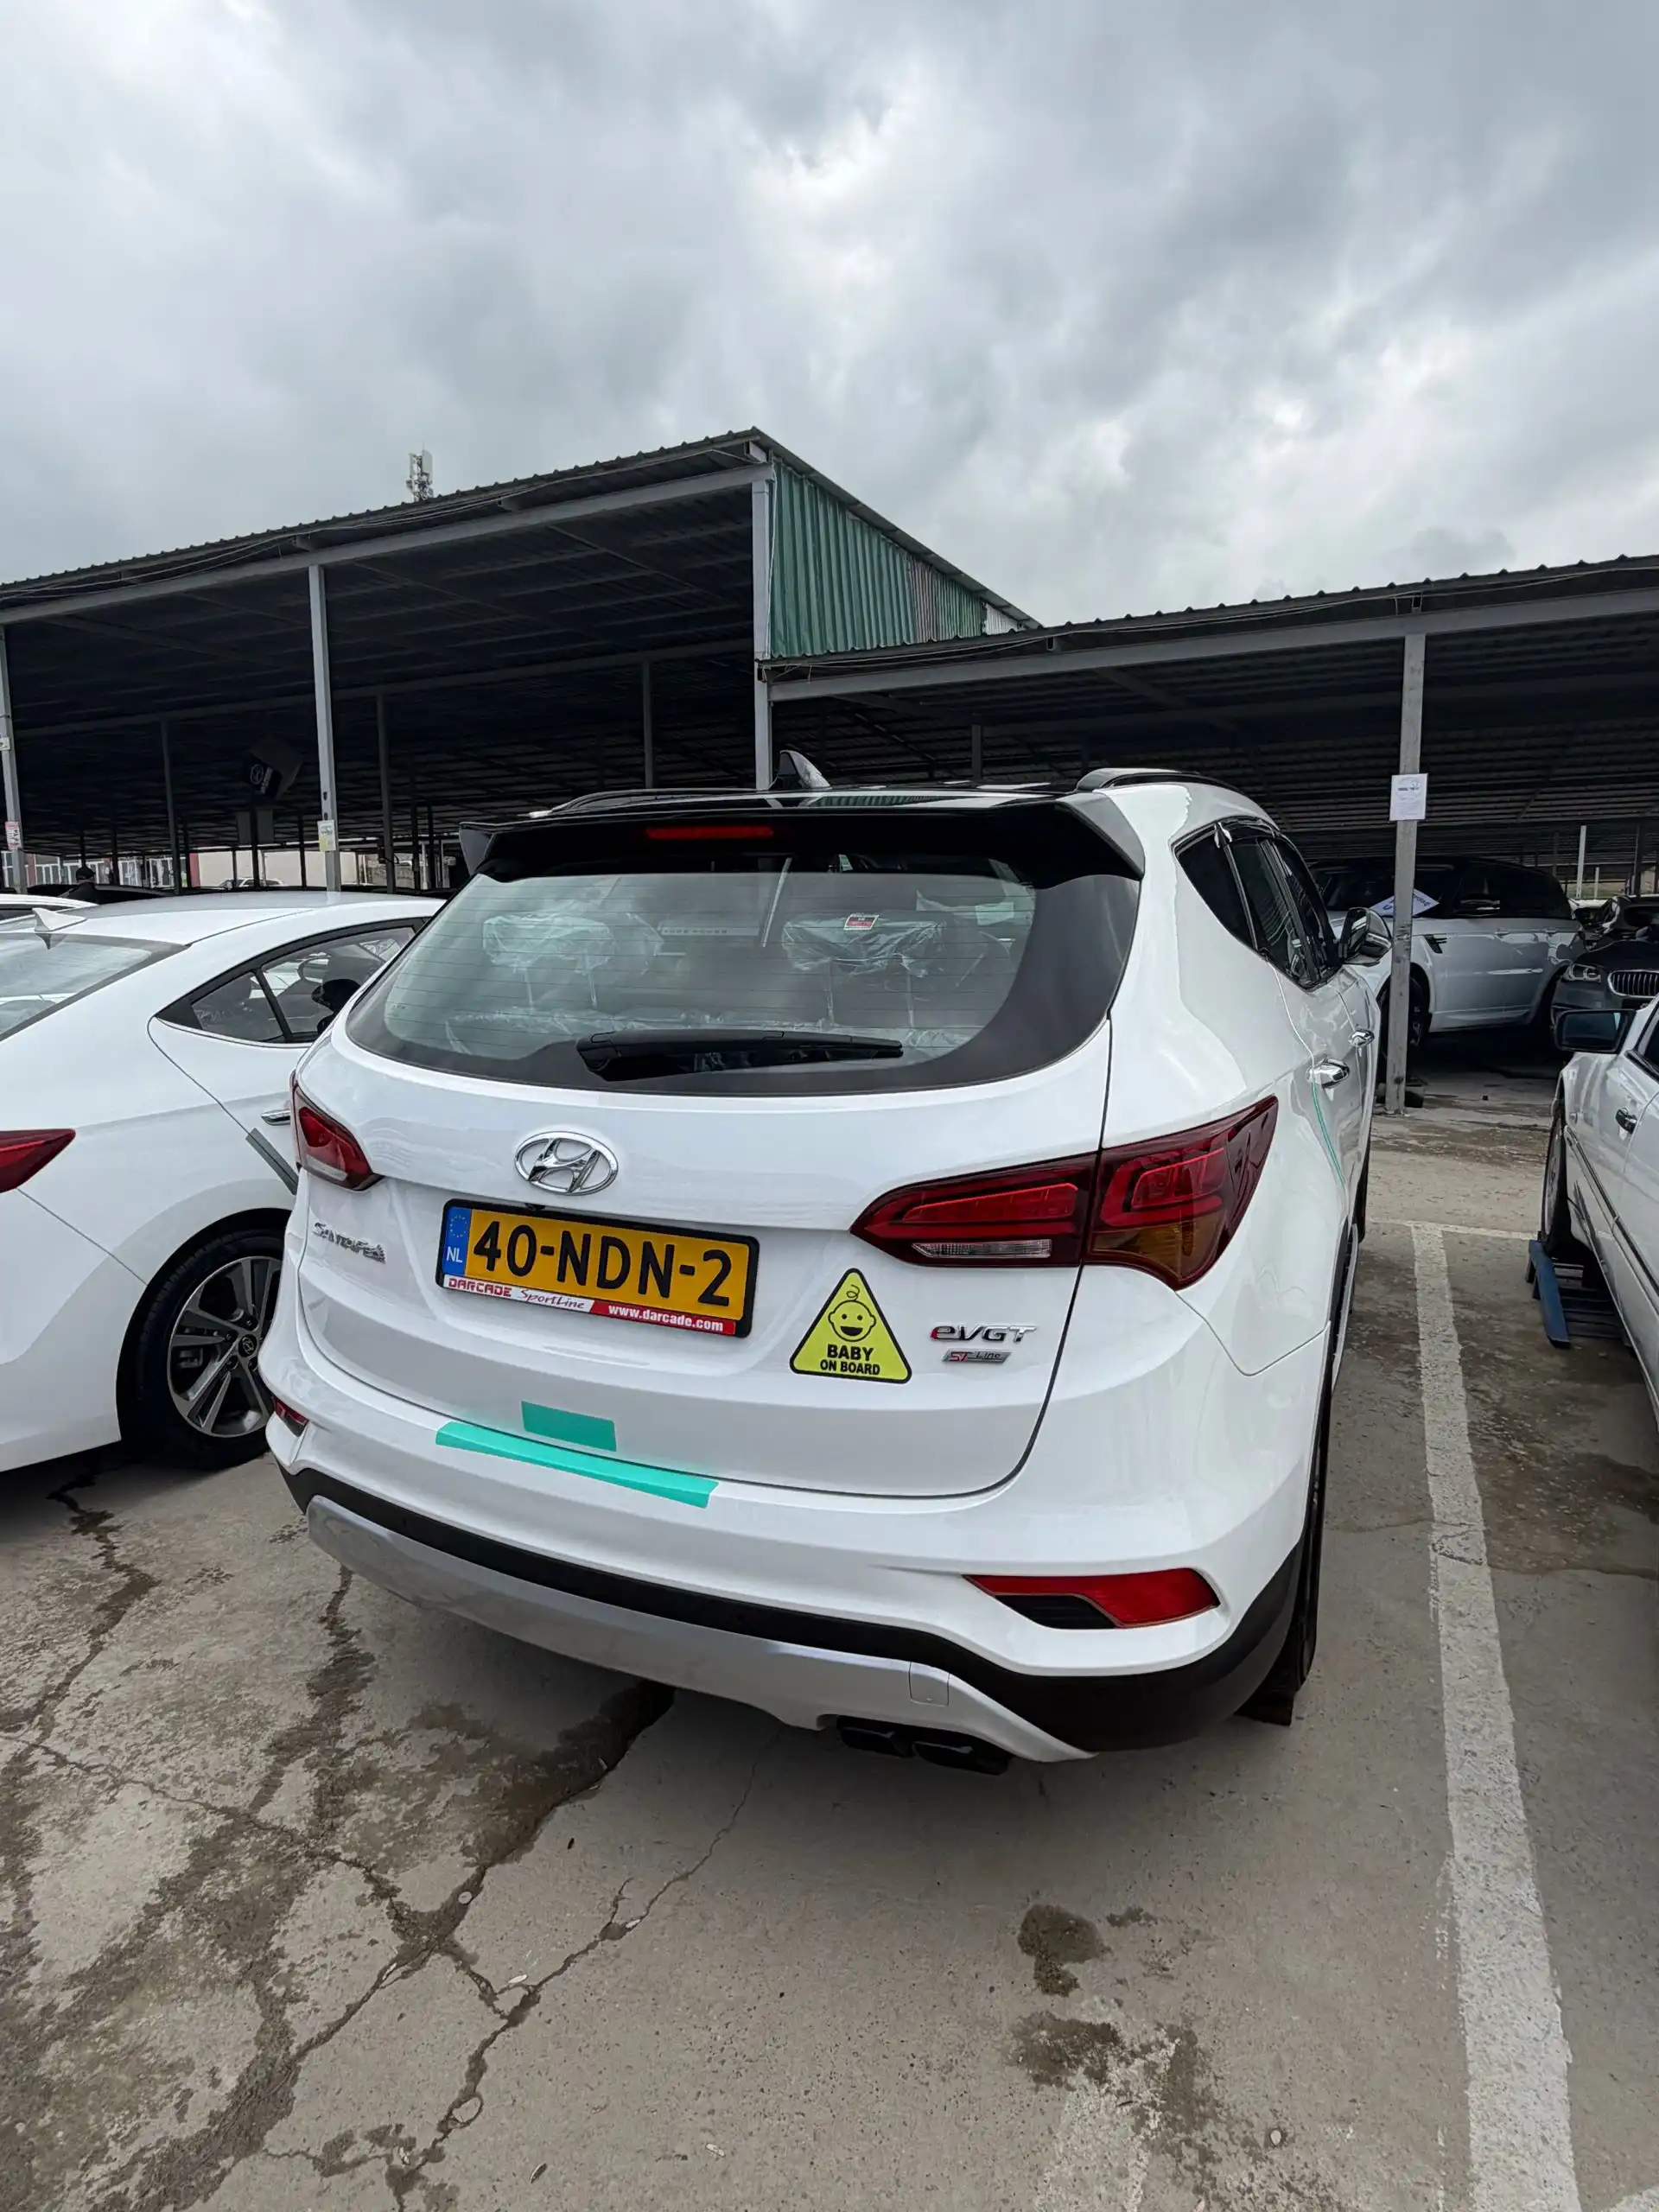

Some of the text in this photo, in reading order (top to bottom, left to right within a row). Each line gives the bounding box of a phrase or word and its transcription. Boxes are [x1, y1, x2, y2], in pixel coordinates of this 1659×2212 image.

[446, 1245, 463, 1263] NL
[473, 1220, 733, 1307] 40-NDN-2
[448, 1277, 512, 1297] DARCADE
[608, 1304, 724, 1332] www.darcade.com
[826, 1344, 874, 1362] BABY
[819, 1359, 881, 1376] ON BOARD
